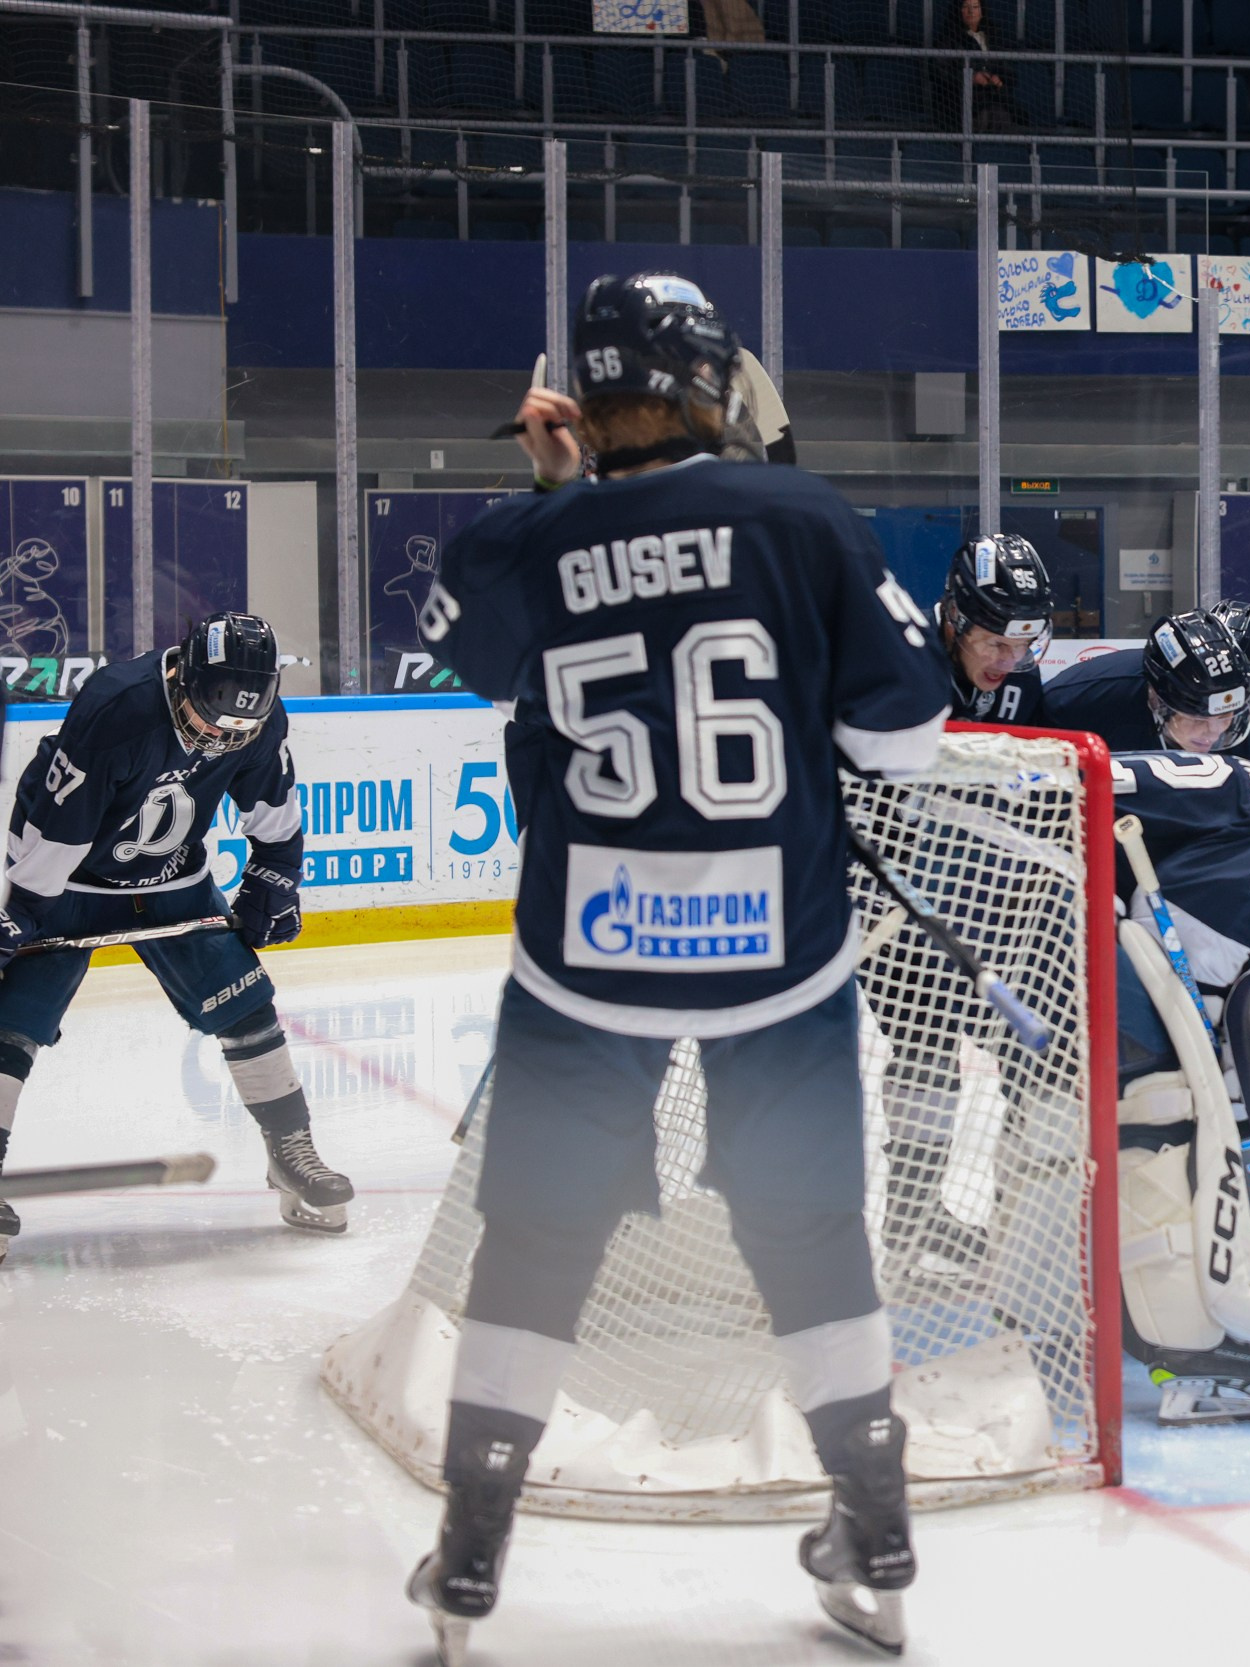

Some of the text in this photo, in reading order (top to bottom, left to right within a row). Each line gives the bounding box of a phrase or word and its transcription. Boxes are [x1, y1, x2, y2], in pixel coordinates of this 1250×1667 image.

[586, 347, 622, 382] 56
[63, 487, 80, 506] 10
[109, 487, 123, 507] 11
[224, 491, 241, 510] 12
[375, 499, 390, 516] 17
[557, 526, 732, 615] GUSEV
[1013, 569, 1038, 591] 95
[1205, 654, 1233, 678] 22
[235, 690, 260, 710] 67
[998, 684, 1022, 722] A
[543, 618, 788, 821] 56
[45, 750, 86, 805] 67
[637, 891, 769, 928] ГАЗПРОМ
[638, 934, 769, 957] ЭКСПОРТ
[201, 964, 266, 1014] BAUER
[1208, 1147, 1244, 1285] CCM
